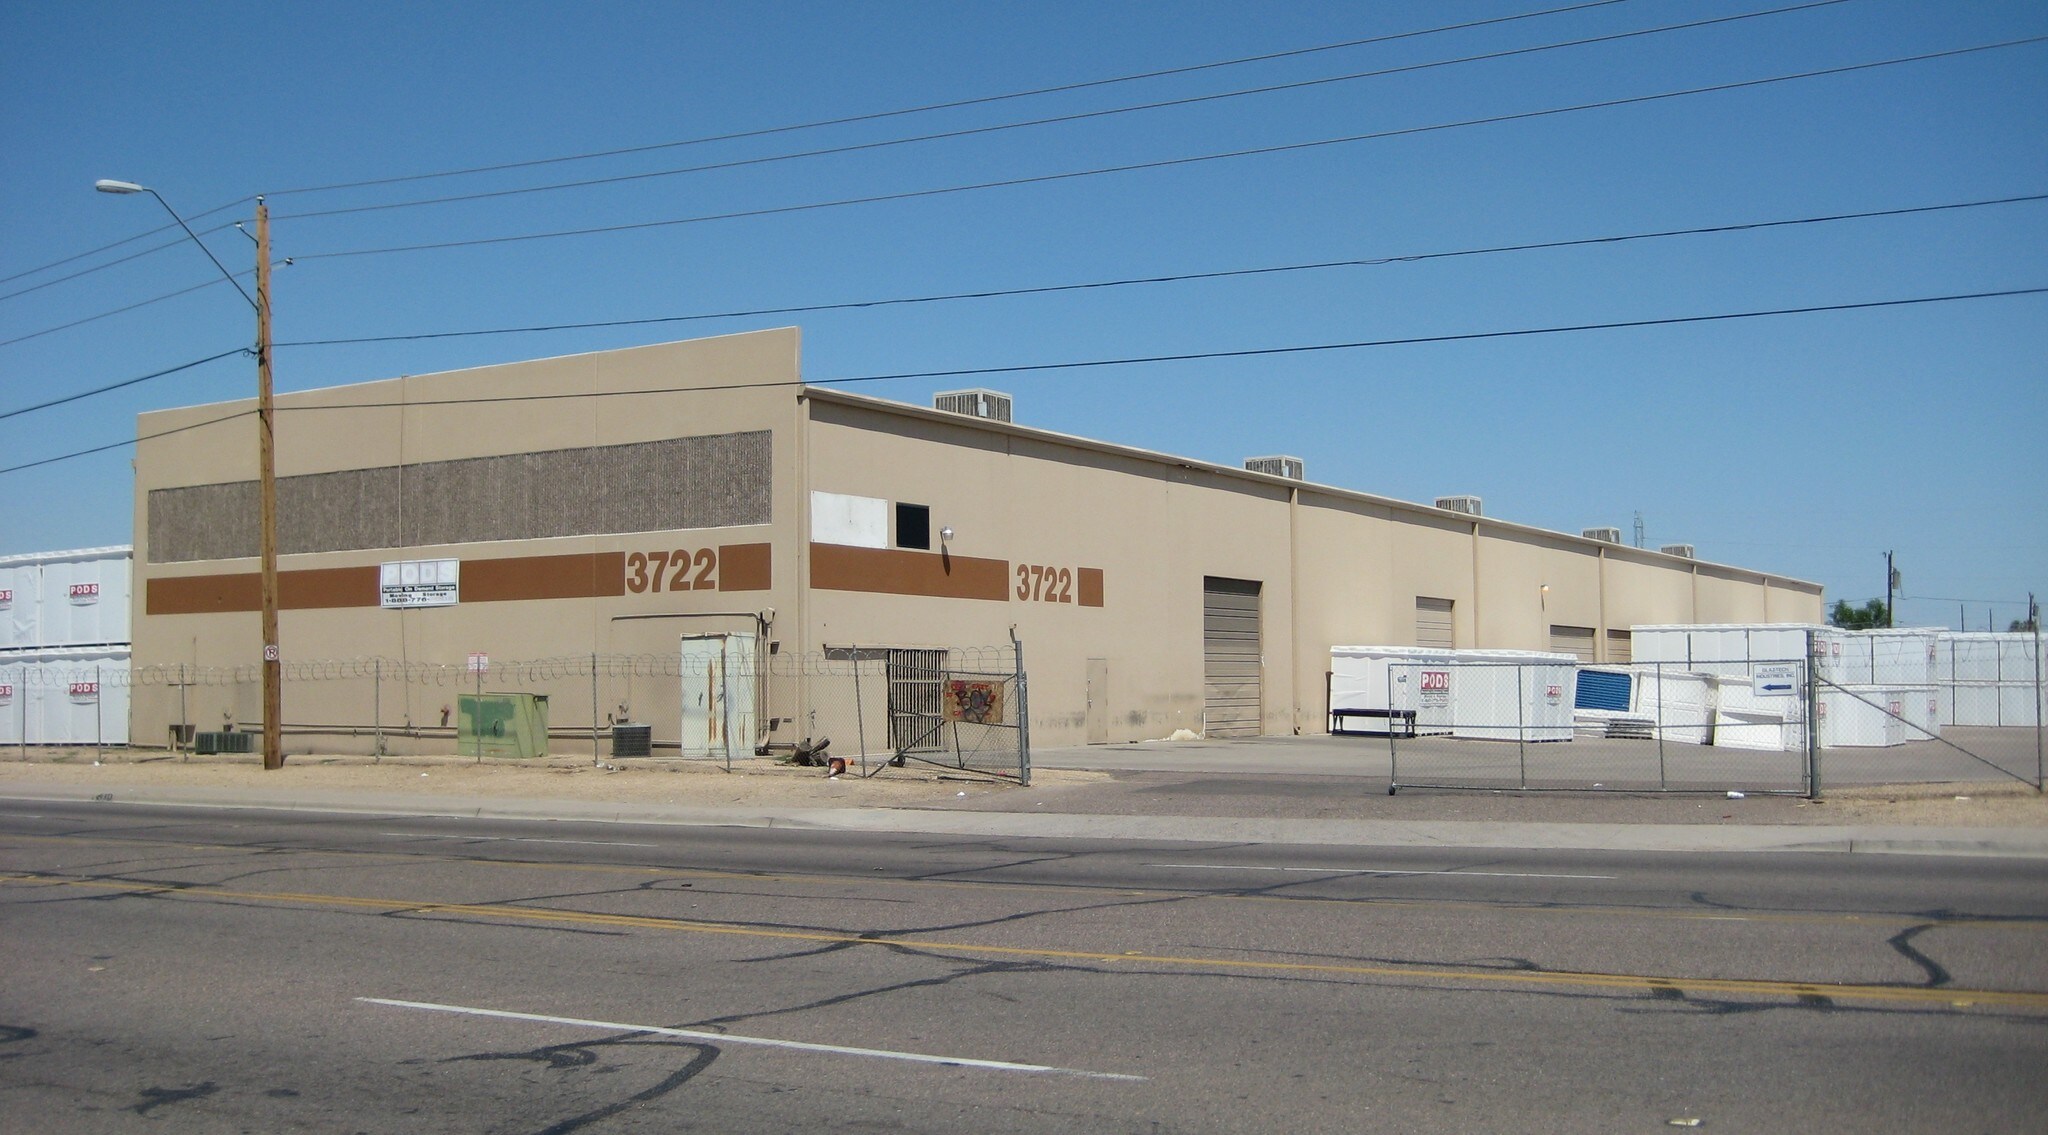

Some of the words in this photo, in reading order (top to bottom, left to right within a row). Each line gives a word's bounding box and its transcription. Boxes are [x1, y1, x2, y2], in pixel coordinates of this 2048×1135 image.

[626, 547, 717, 594] 3722
[70, 585, 98, 595] PODS
[1016, 563, 1072, 603] 3722
[1422, 673, 1449, 688] PODS
[70, 684, 98, 693] PODS
